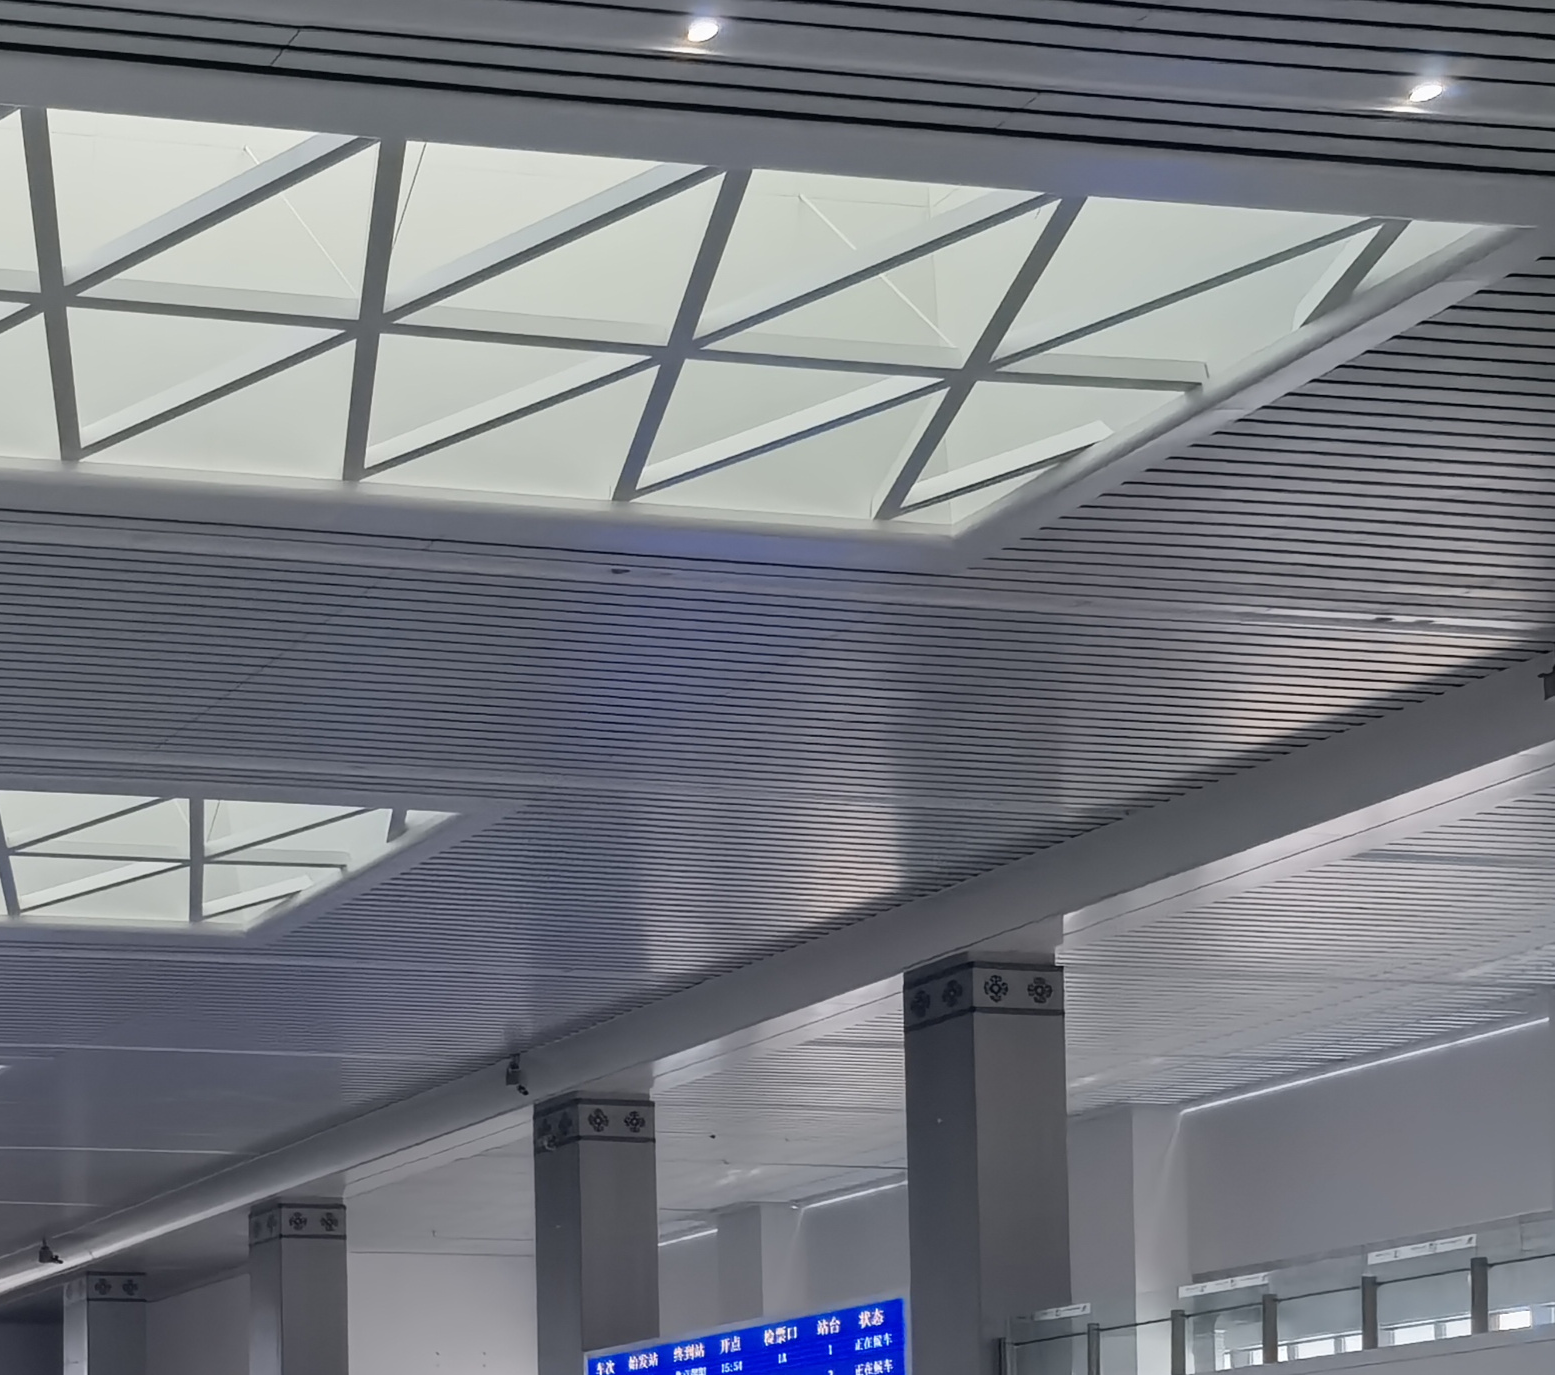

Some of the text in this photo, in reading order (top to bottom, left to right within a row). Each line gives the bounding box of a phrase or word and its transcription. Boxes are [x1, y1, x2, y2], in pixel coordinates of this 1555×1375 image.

[628, 1352, 658, 1371] 始发站
[673, 1343, 705, 1362] 终到站
[720, 1336, 741, 1355] 开点
[764, 1326, 797, 1346] 检票口
[816, 1316, 840, 1336] 站台
[858, 1308, 884, 1329] 状态
[855, 1332, 893, 1351] 正在候车
